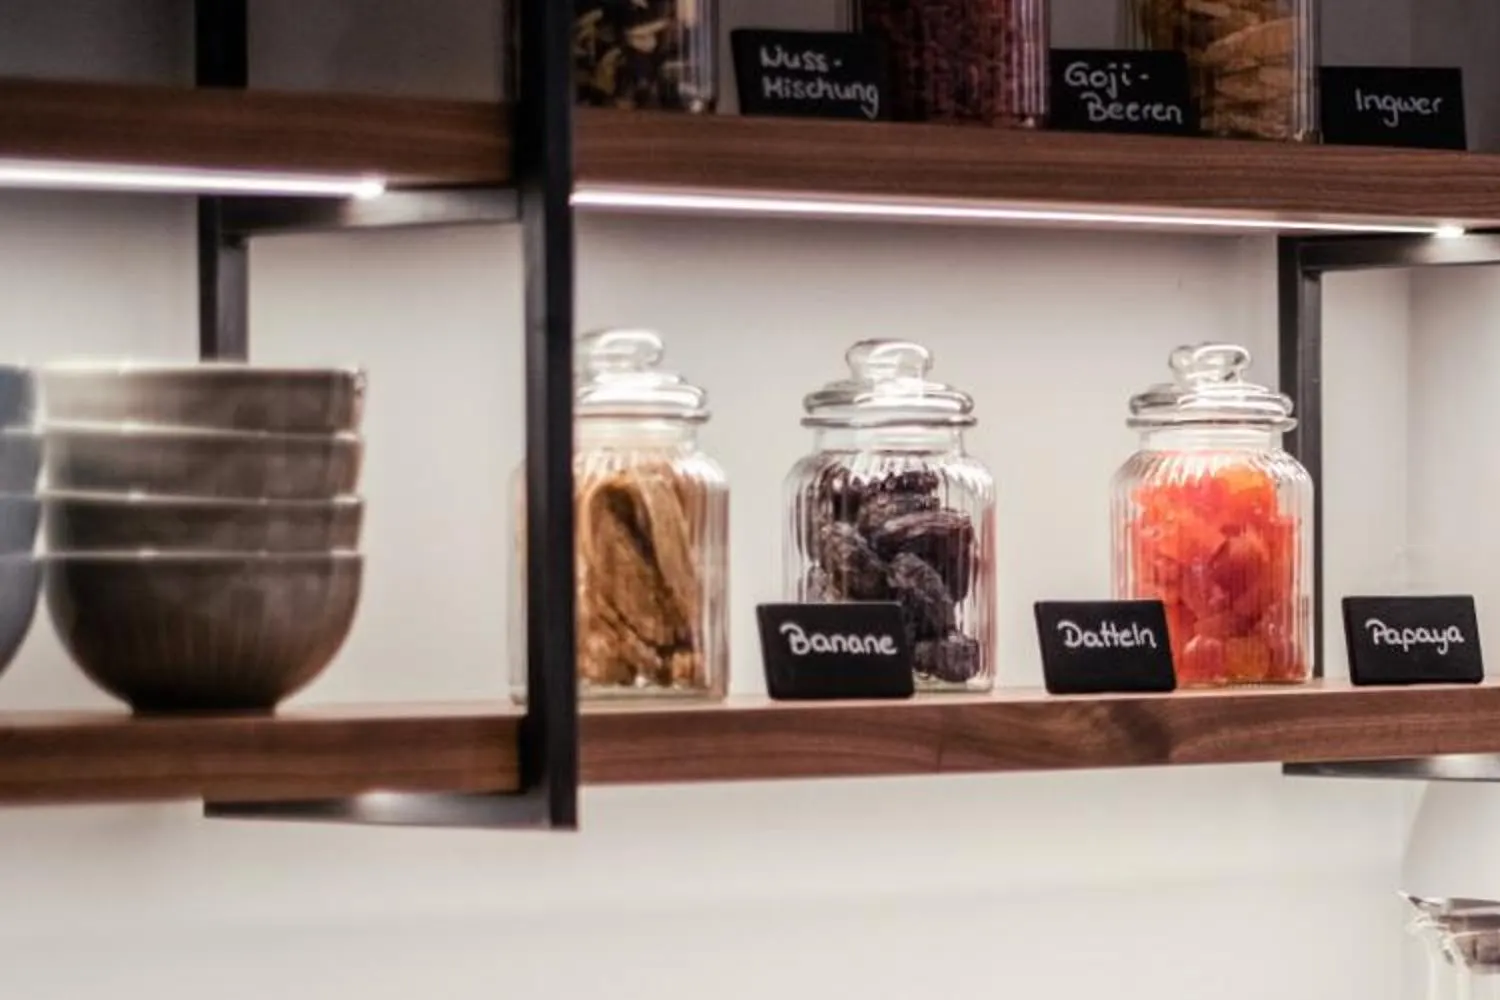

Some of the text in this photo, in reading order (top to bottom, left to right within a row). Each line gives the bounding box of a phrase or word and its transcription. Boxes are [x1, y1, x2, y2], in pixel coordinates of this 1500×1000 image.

[1064, 61, 1149, 99] Goji-
[1081, 91, 1183, 124] Beeren
[1355, 87, 1443, 128] Ingwer
[780, 622, 898, 657] Banane
[1056, 619, 1156, 650] Datteln
[1366, 618, 1465, 654] Papaya
